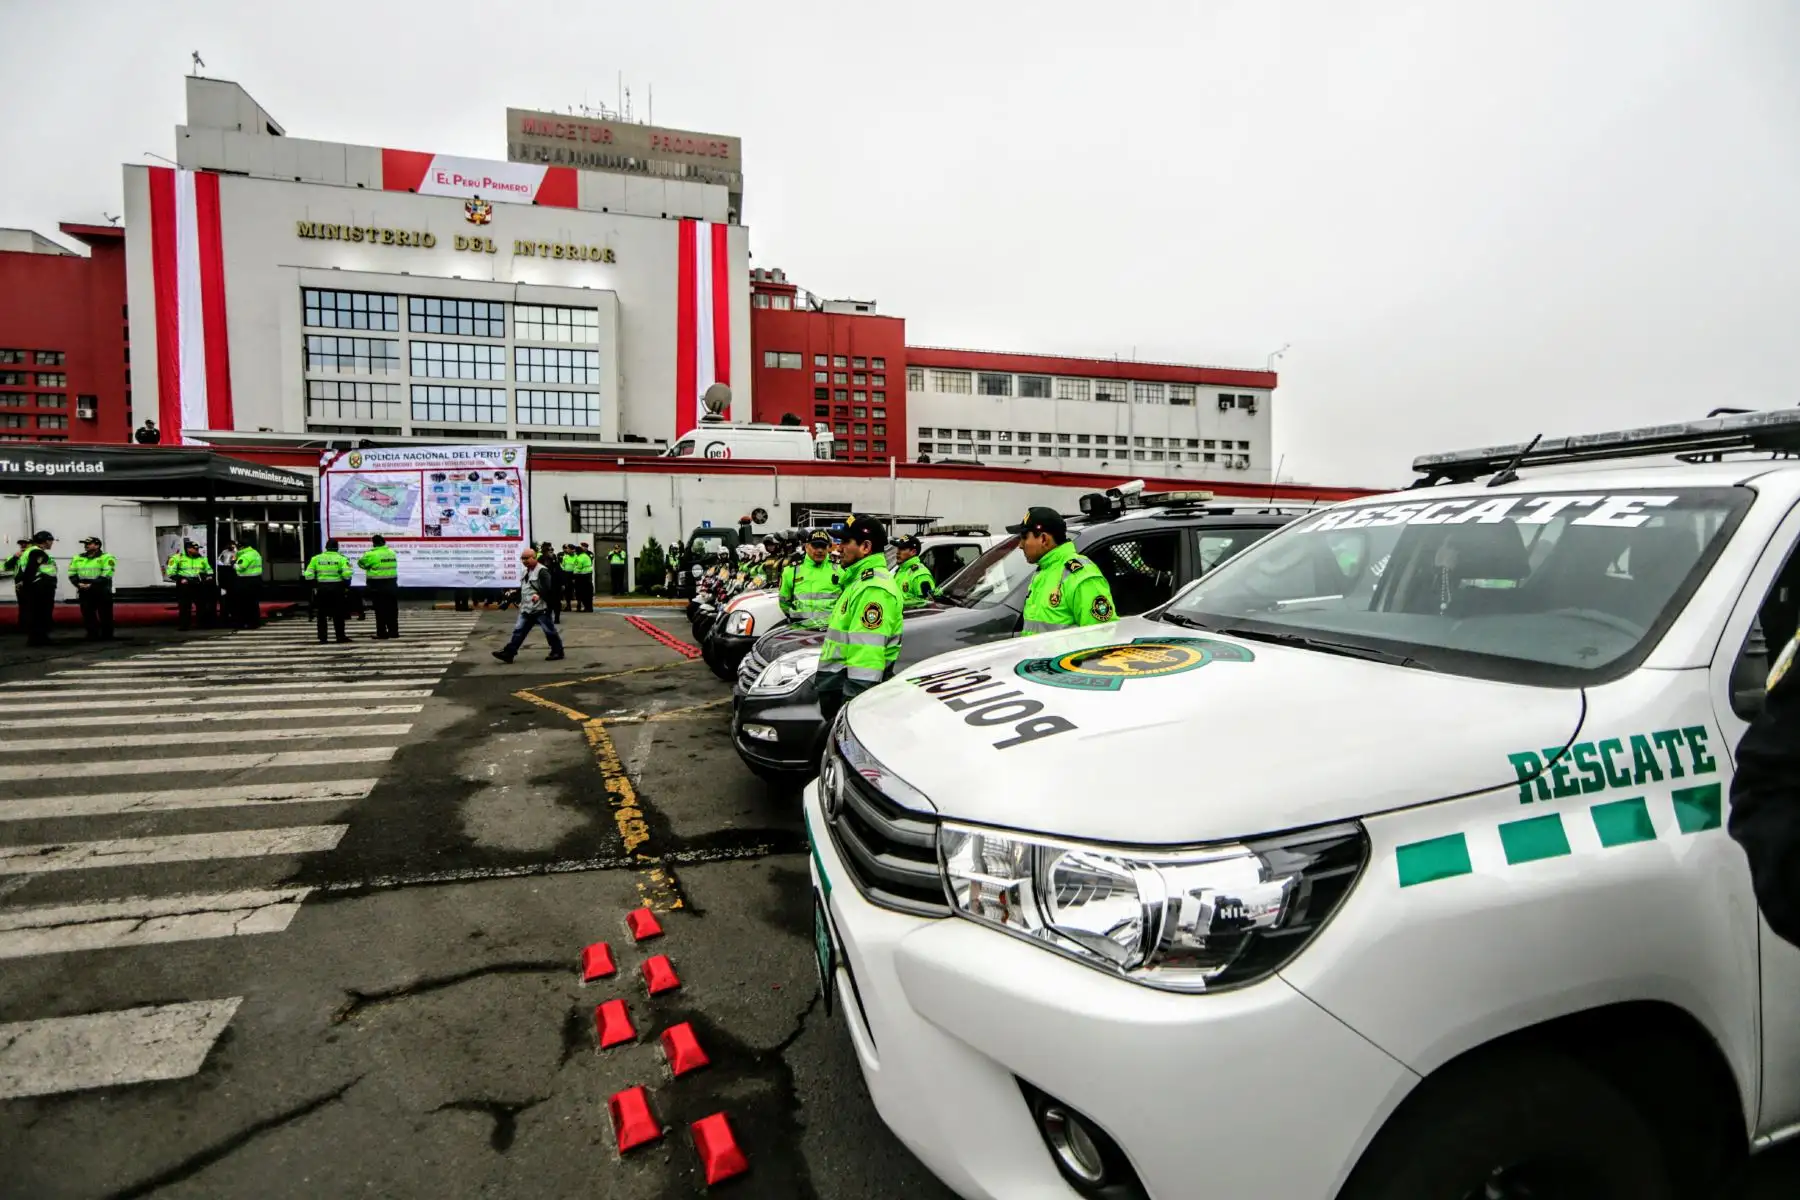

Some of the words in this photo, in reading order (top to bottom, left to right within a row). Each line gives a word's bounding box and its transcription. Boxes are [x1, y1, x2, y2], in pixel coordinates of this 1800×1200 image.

[520, 116, 613, 144] MINCETUR
[650, 133, 729, 159] PRODUCE
[297, 220, 436, 248] MINISTERIO
[453, 234, 497, 253] DEL
[513, 239, 616, 263] INTERIOR
[0, 460, 20, 472] Tu
[24, 460, 105, 476] Seguridad
[365, 453, 400, 461] POLICIA
[403, 452, 449, 460] NACIONAL
[452, 451, 471, 459] DEL
[1297, 495, 1679, 534] RESCATE
[1507, 725, 1716, 804] RESCATE
